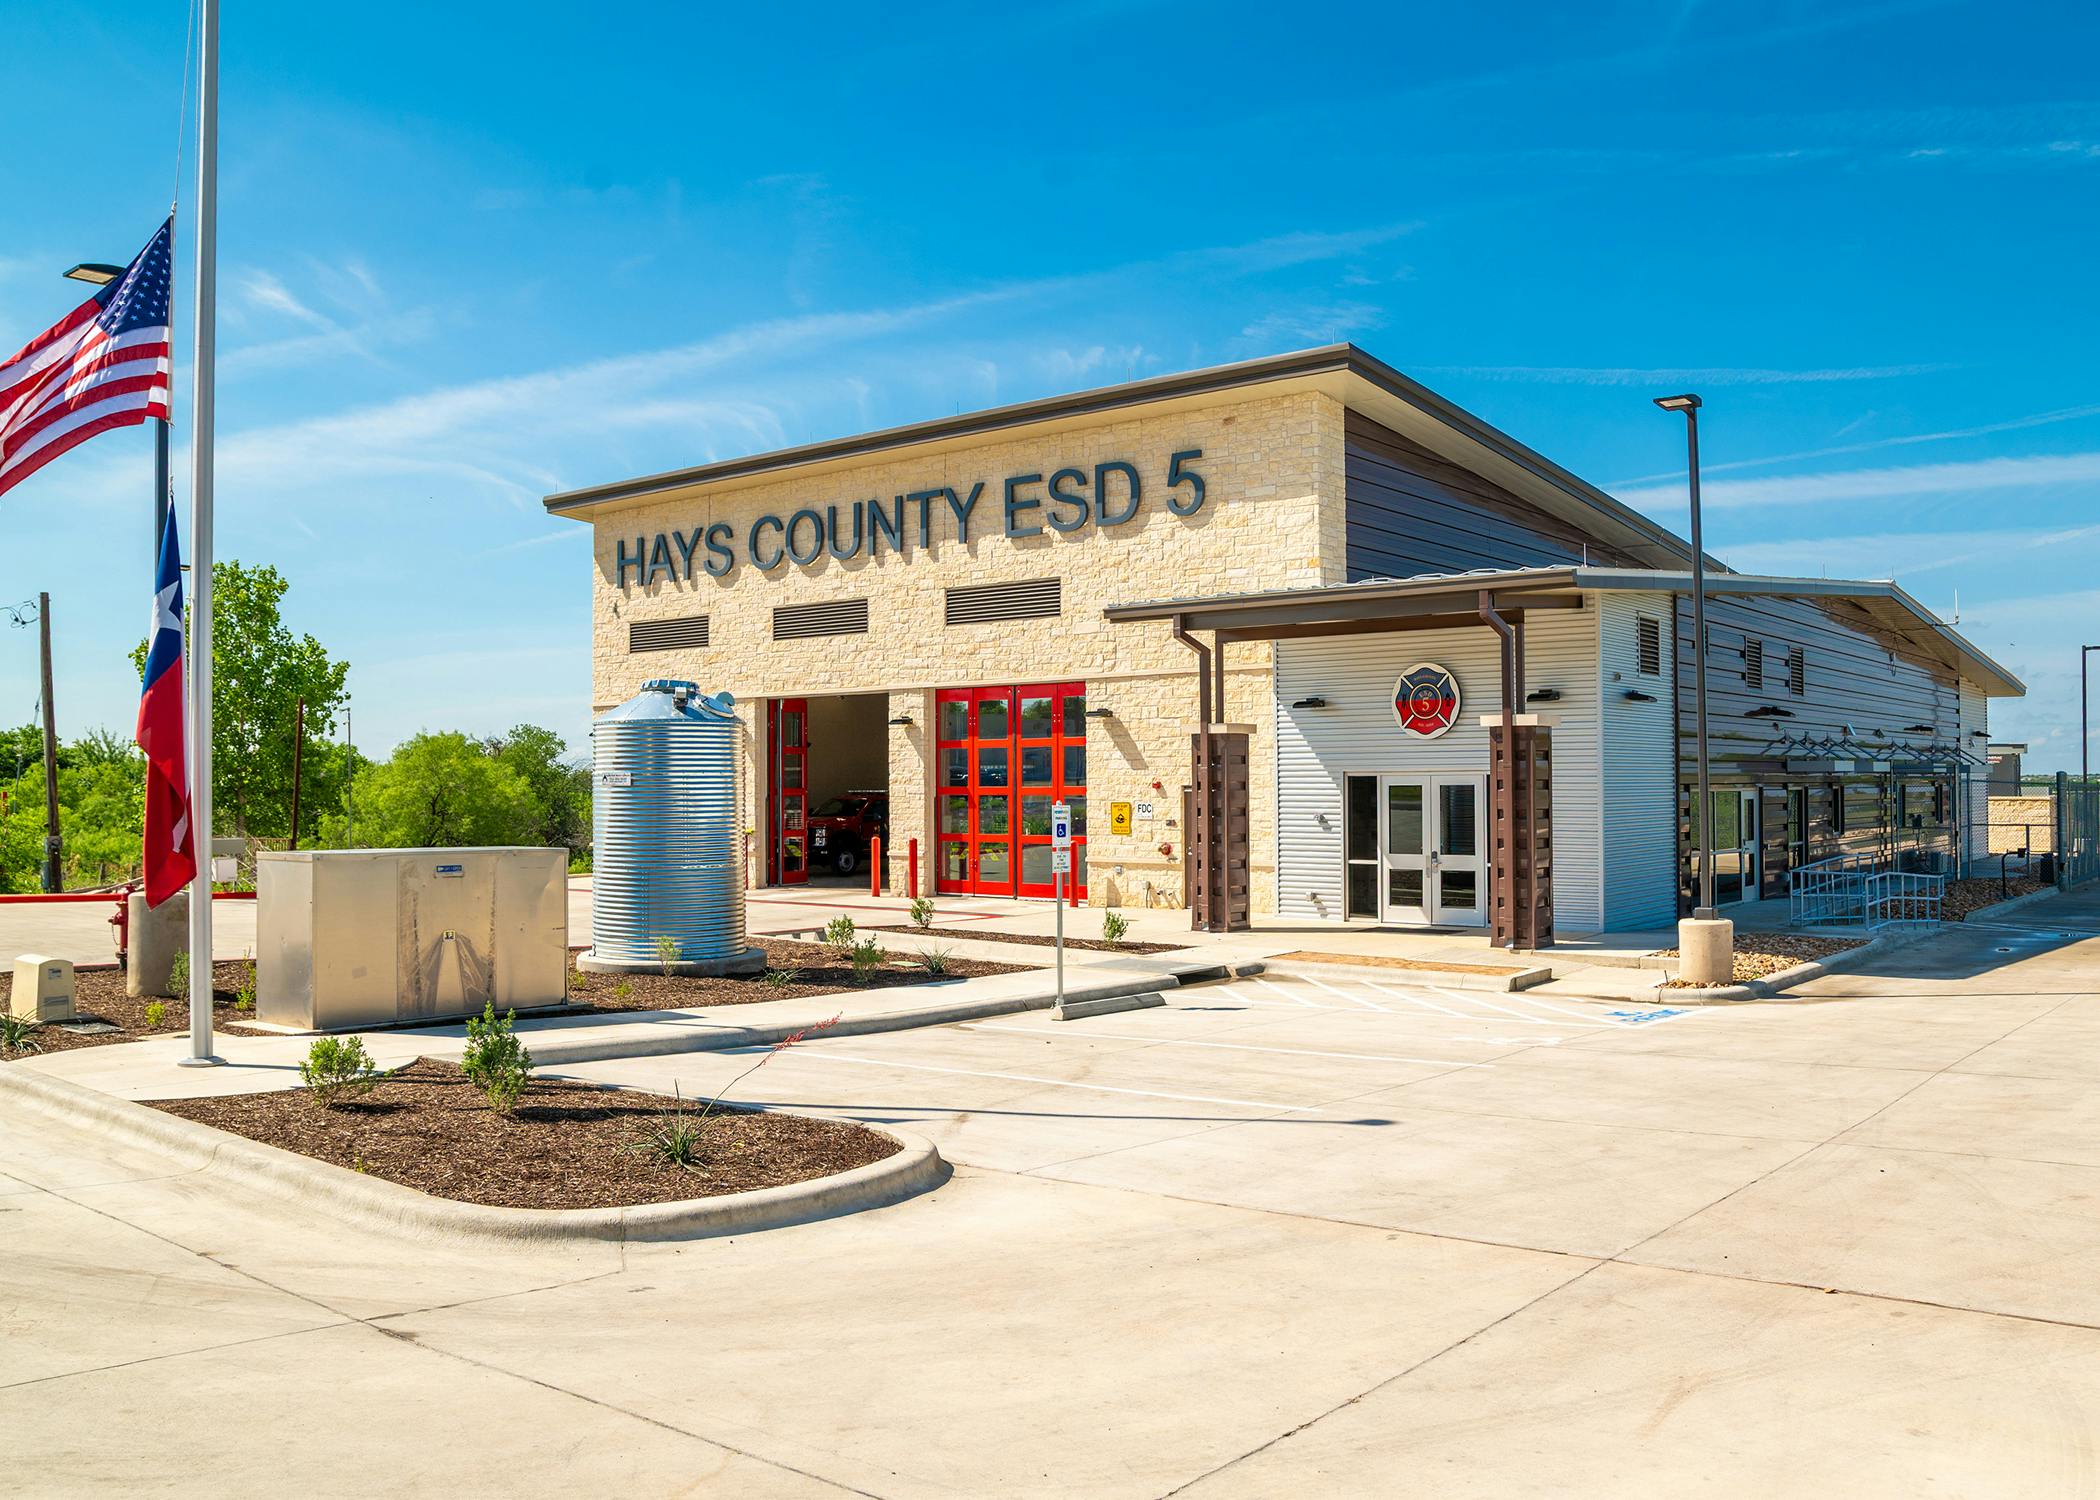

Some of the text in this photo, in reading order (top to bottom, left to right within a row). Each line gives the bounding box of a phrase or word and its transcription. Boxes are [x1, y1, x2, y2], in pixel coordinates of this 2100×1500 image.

[616, 450, 1207, 589] HAYS COUNTY ESD 5
[1422, 697, 1430, 712] 5
[1137, 803, 1152, 813] FDC
